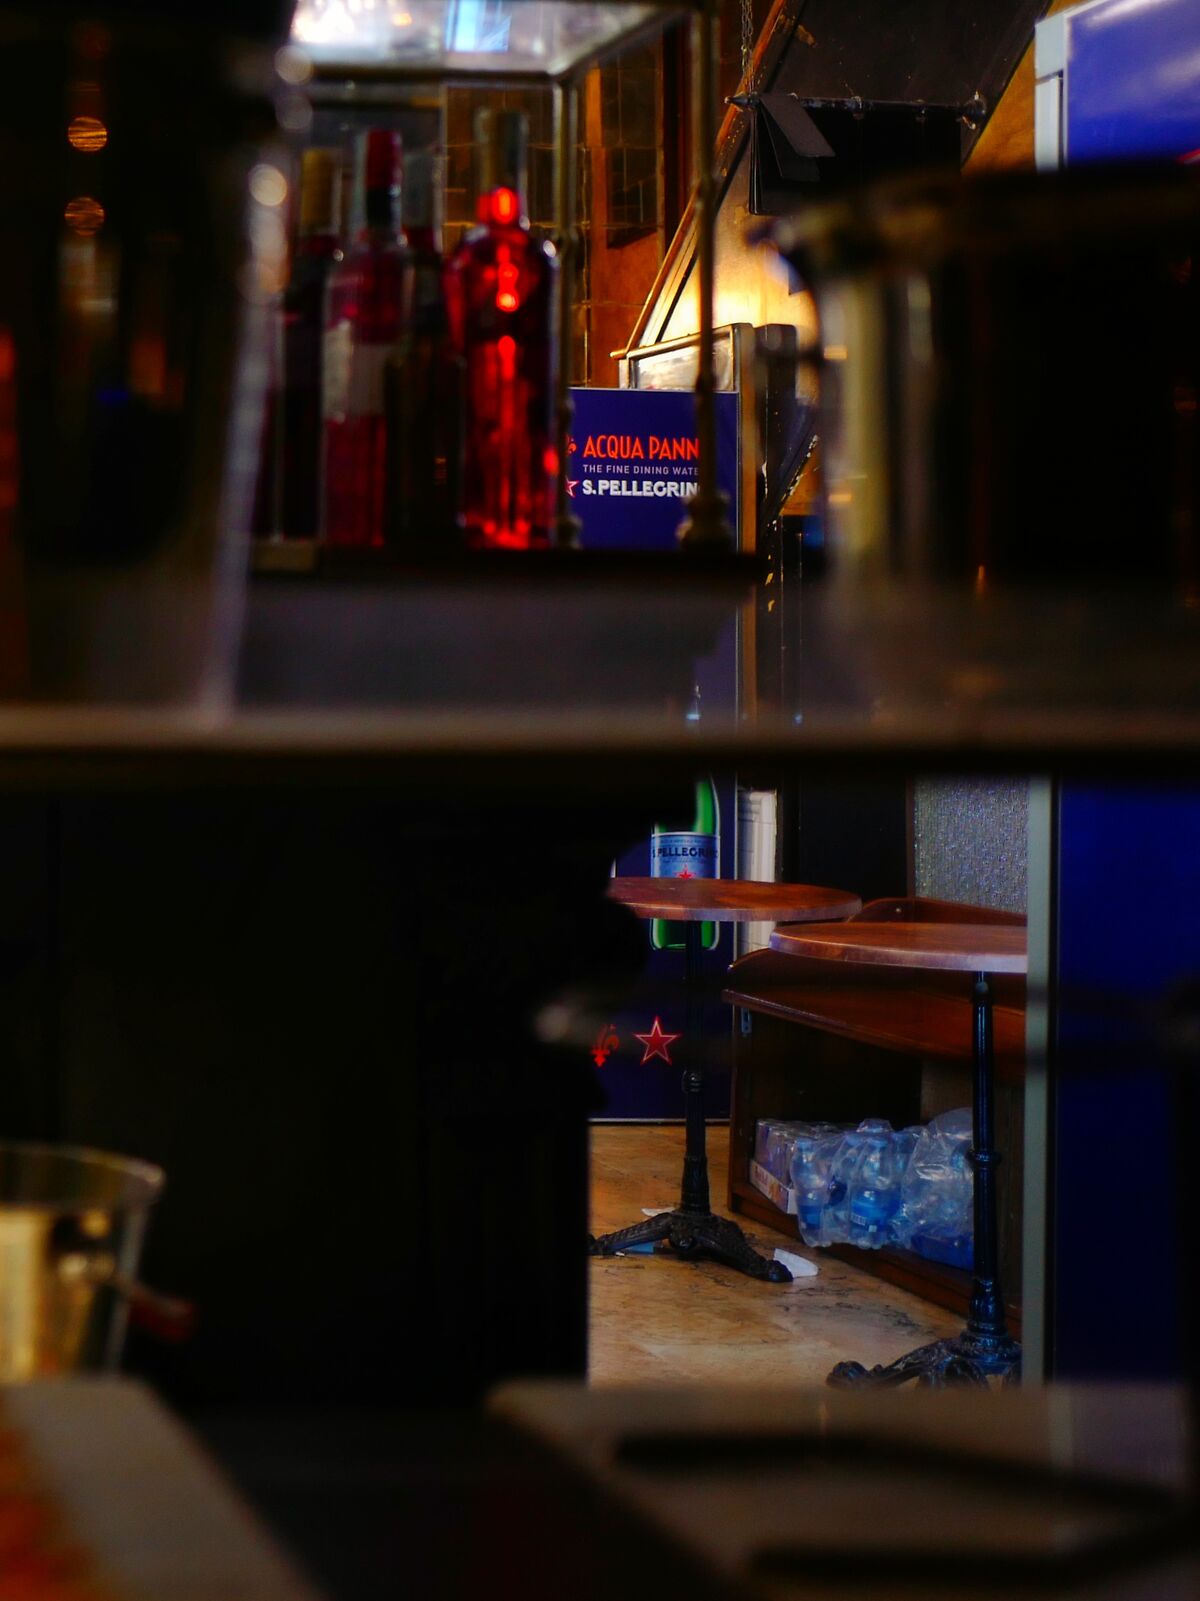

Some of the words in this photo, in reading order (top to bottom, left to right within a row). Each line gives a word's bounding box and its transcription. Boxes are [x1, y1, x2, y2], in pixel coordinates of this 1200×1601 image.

[583, 435, 644, 459] ACQUA
[649, 436, 699, 460] PANN
[583, 464, 603, 473] THE
[606, 465, 630, 474] FINE
[633, 466, 669, 475] DINING
[672, 467, 699, 476] WATE
[582, 480, 701, 497] S.PELLEGRIN
